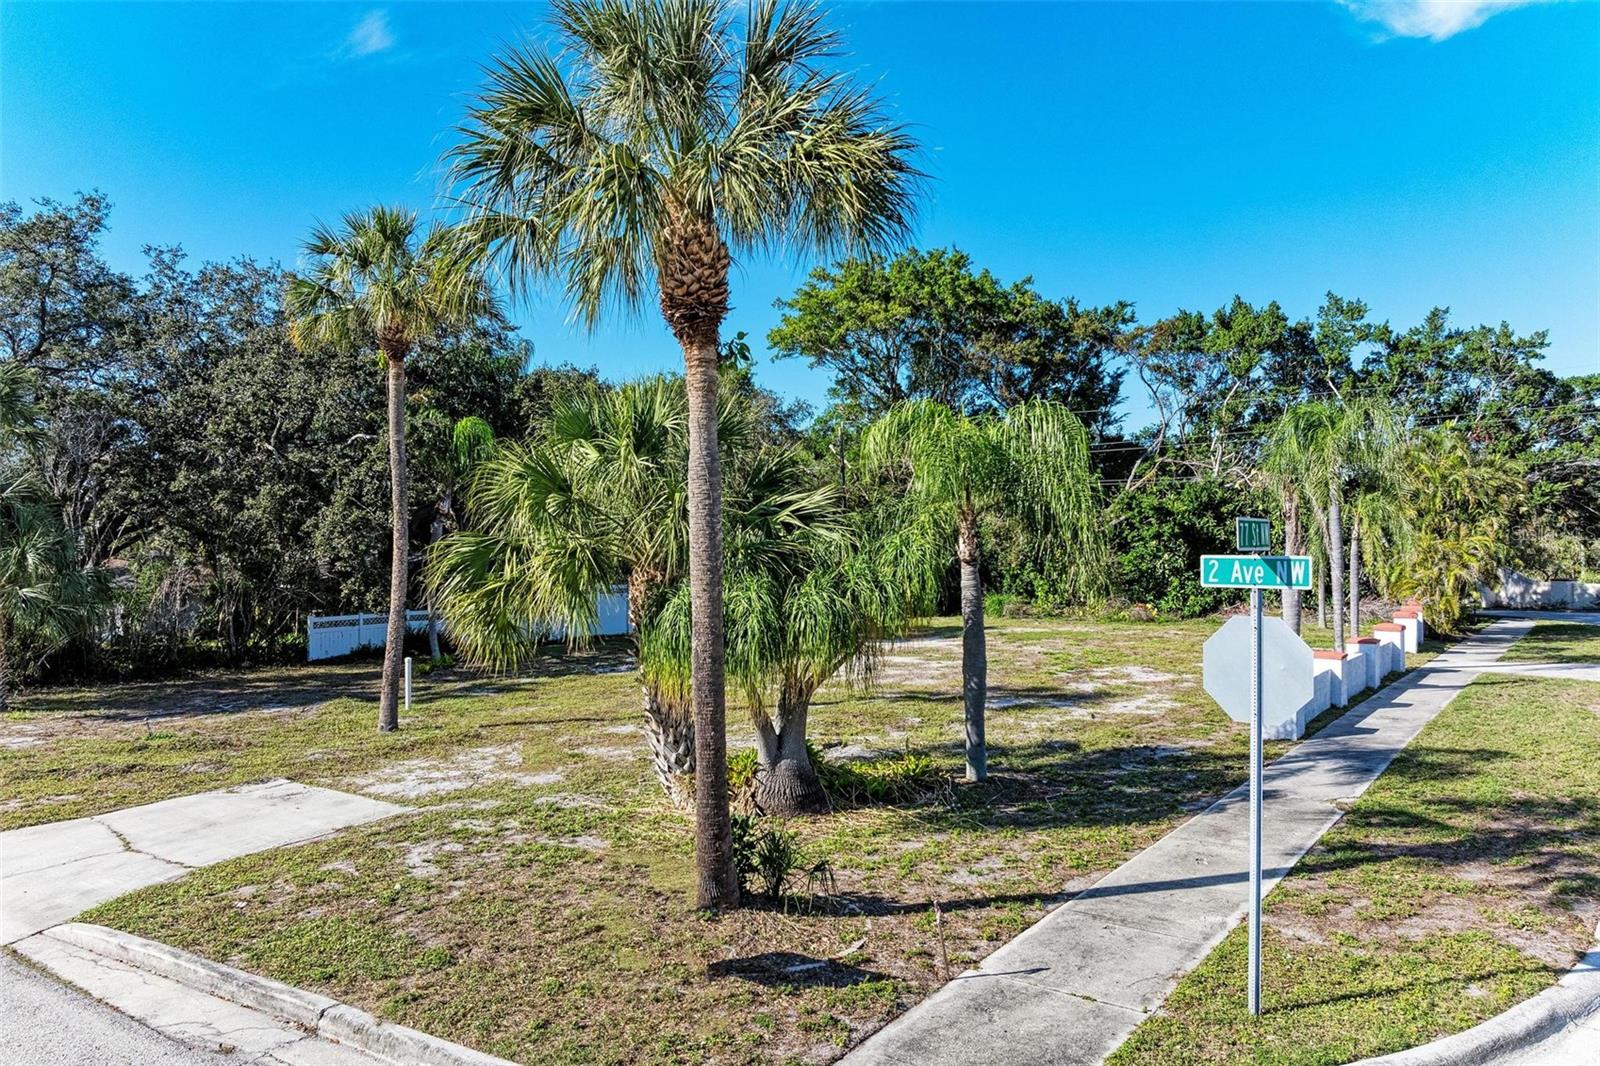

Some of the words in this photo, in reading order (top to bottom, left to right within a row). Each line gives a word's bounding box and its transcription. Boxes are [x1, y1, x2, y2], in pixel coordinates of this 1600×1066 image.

[1208, 559, 1219, 583] 2
[1230, 560, 1264, 584] Ave
[1276, 560, 1305, 584] NW
